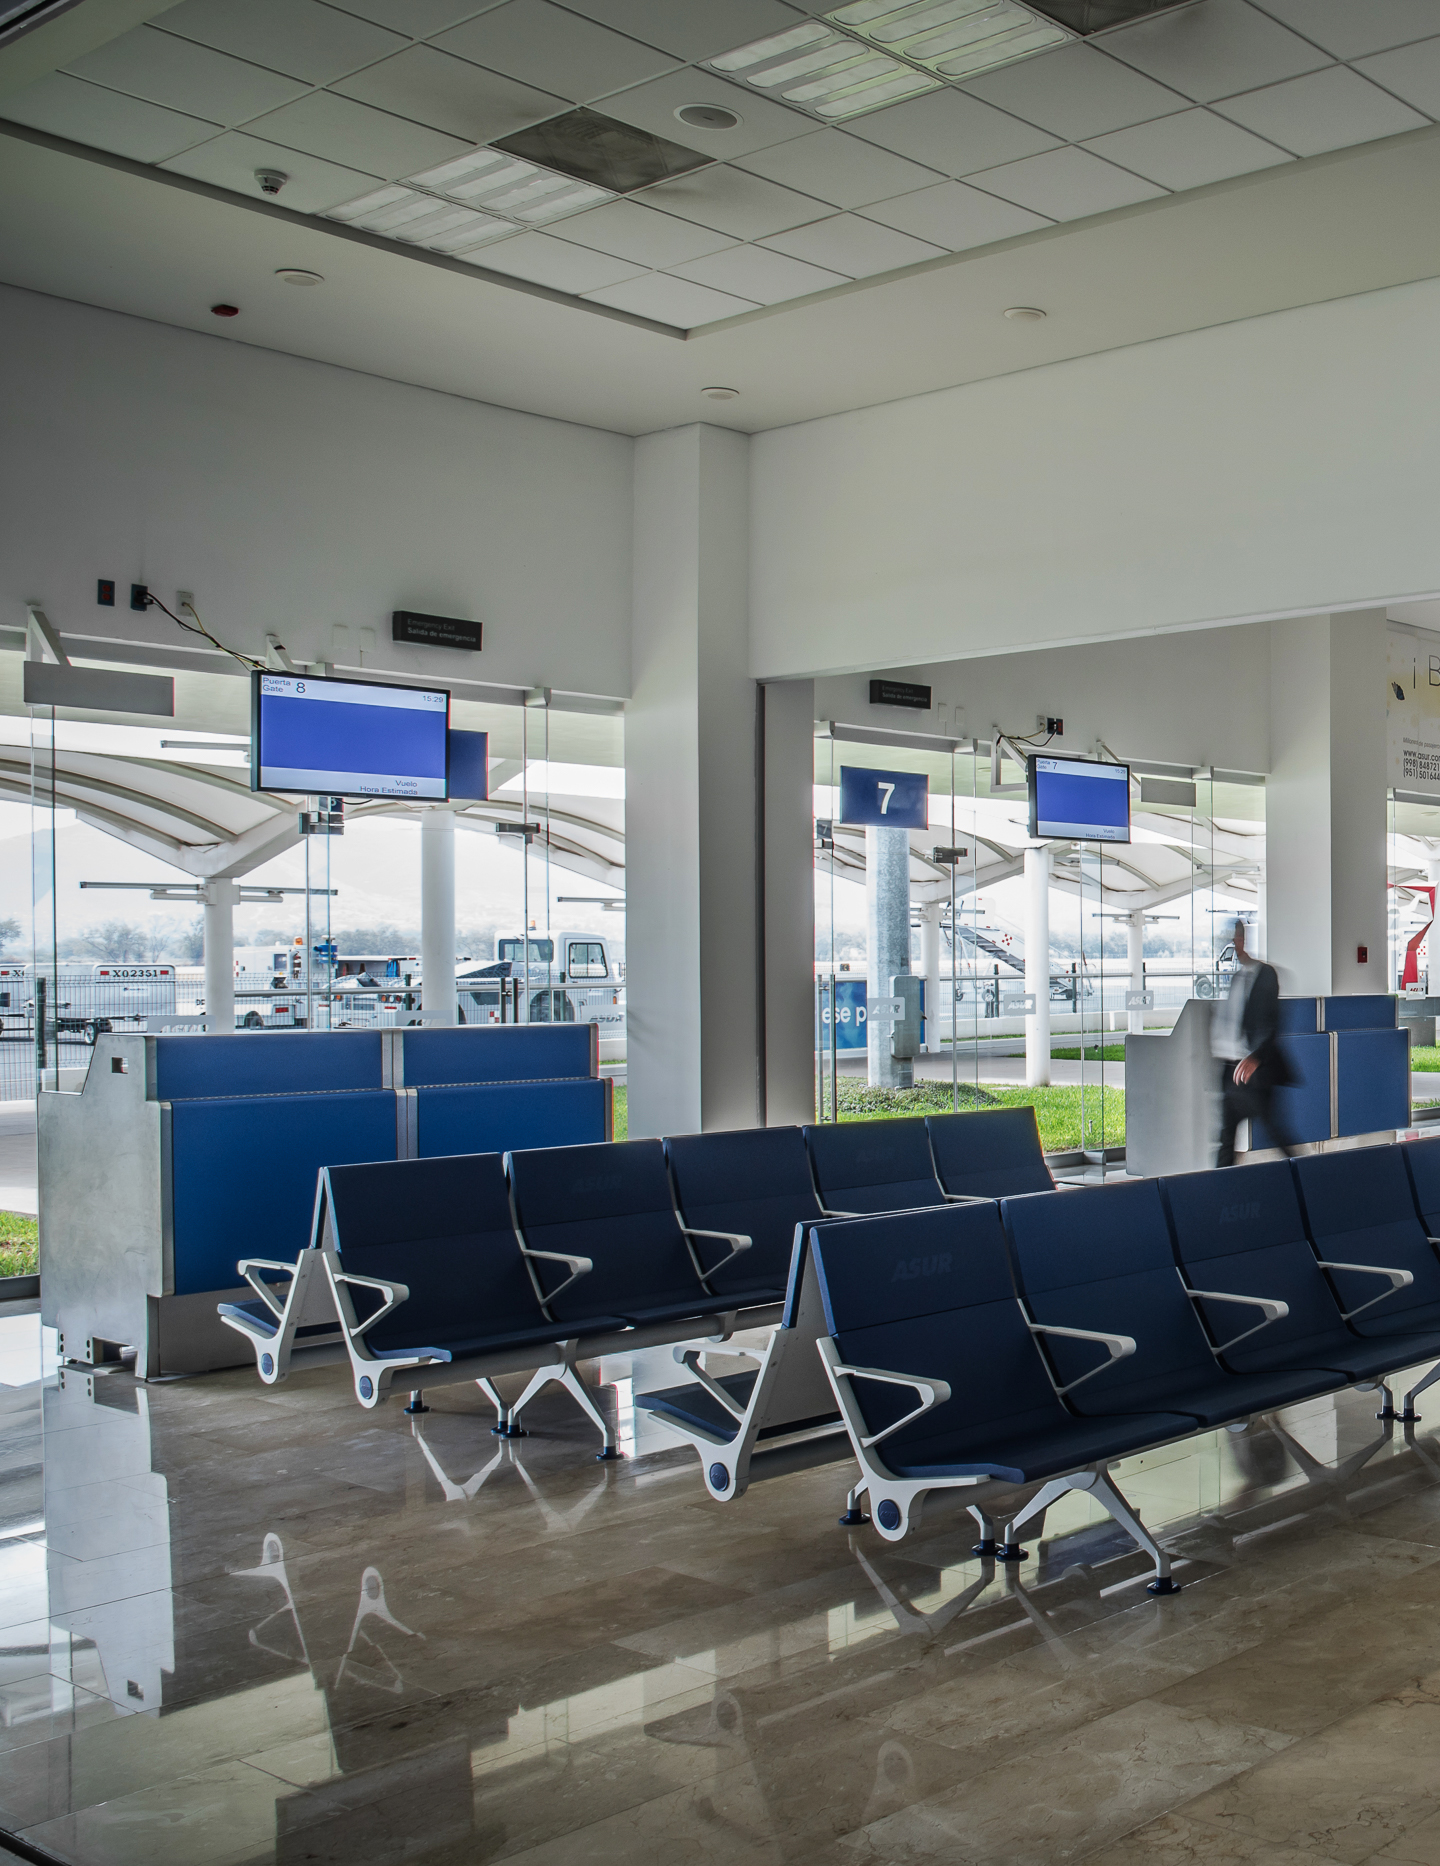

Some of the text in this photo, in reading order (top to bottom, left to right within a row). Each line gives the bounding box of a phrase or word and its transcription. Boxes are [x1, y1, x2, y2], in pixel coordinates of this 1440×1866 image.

[407, 627, 428, 636] Salida
[439, 632, 477, 643] emergencia
[262, 677, 307, 694] Puerta 8
[262, 684, 284, 693] Gate
[422, 695, 444, 703] 15:29
[1052, 761, 1058, 770] 7
[394, 779, 418, 788] Vuelo
[359, 785, 419, 796] Hora Estimada
[877, 781, 896, 815] 7
[821, 824, 828, 835] 7
[112, 969, 158, 978] X02351
[890, 1251, 954, 1283] ASUR
